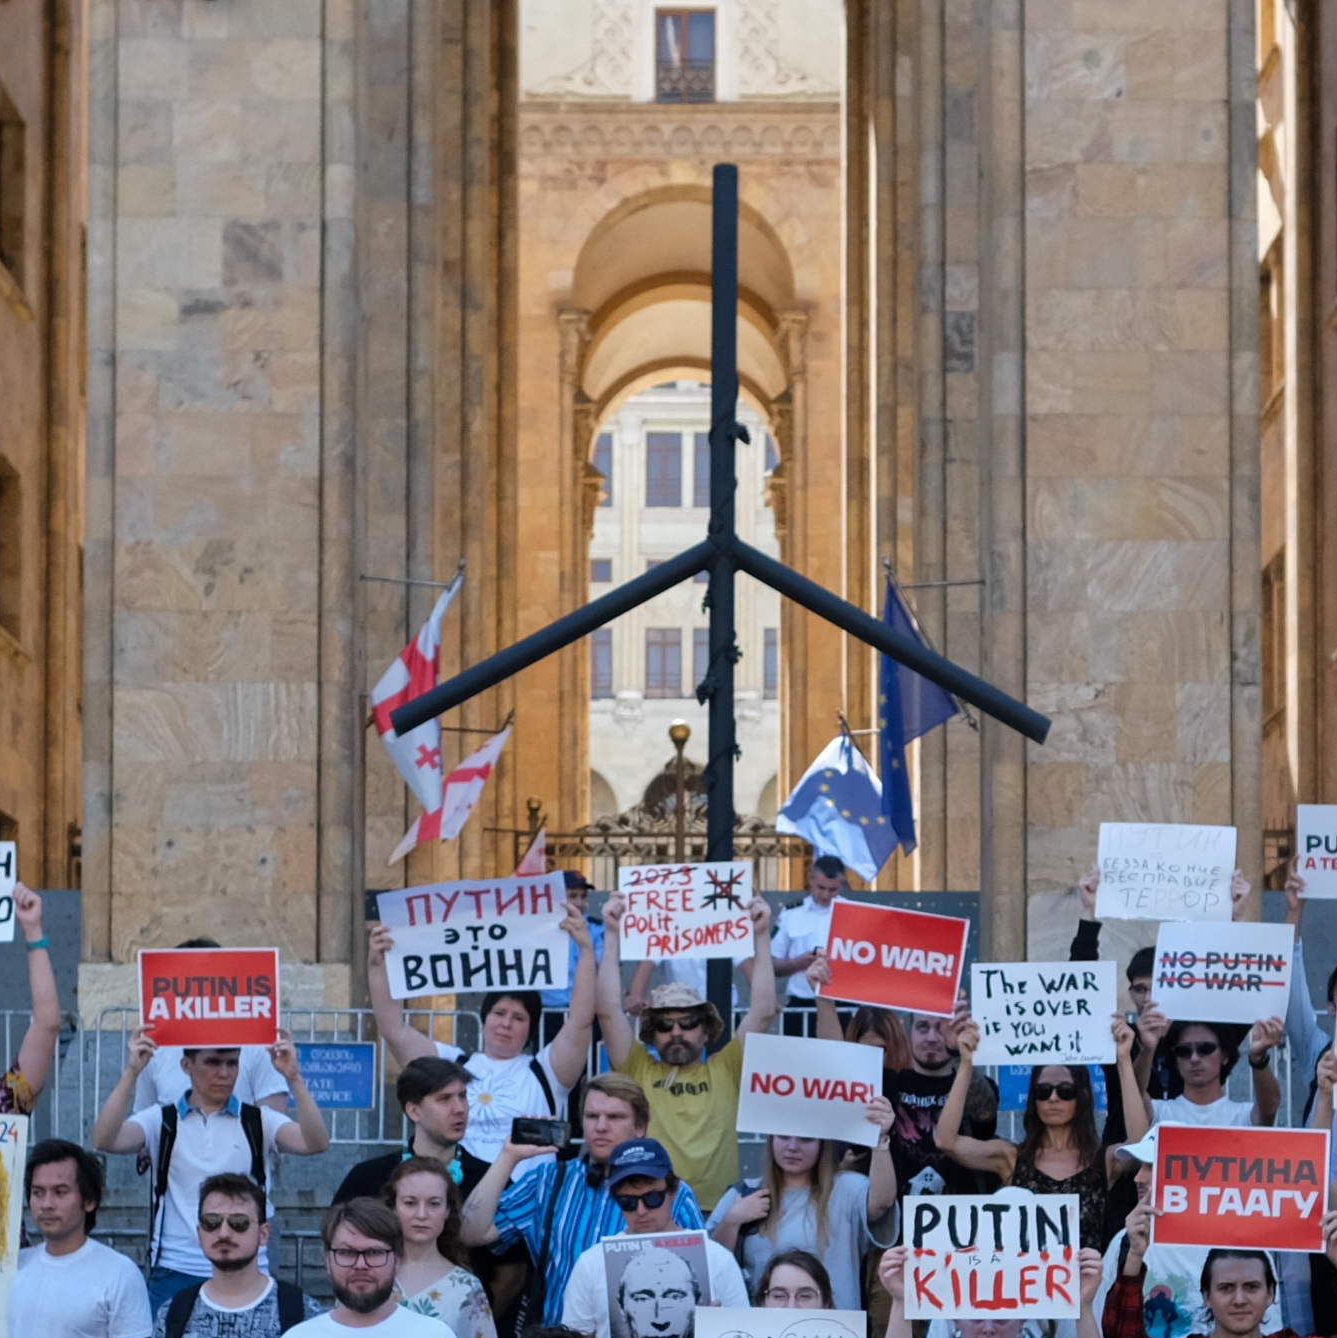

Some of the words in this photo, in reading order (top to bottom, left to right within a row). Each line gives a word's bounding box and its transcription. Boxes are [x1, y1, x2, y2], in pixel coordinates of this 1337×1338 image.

[1305, 857, 1317, 870] A
[405, 883, 553, 926] ПУТИН
[628, 889, 694, 912] FREE
[830, 937, 875, 965] NO
[880, 943, 954, 977] WAR!
[1161, 951, 1197, 969] NO
[1205, 951, 1284, 973] PUTIN
[152, 976, 239, 997] PUTIN
[247, 975, 272, 995] IS
[1038, 971, 1100, 994] WAR
[1160, 971, 1196, 989] NO
[1204, 971, 1263, 992] WAR
[149, 998, 169, 1020] A
[175, 996, 272, 1019] KILLER
[1033, 999, 1091, 1017] OVER
[1010, 1020, 1046, 1038] YOU
[750, 1072, 796, 1097] NO
[803, 1077, 874, 1104] WAR!
[1164, 1154, 1318, 1185] ПУТИНА
[1163, 1186, 1188, 1214] В
[1199, 1186, 1319, 1218] ГААГУ
[913, 1203, 1070, 1251] PUTIN
[606, 1241, 642, 1252] PUTIN
[968, 1255, 981, 1266] IS
